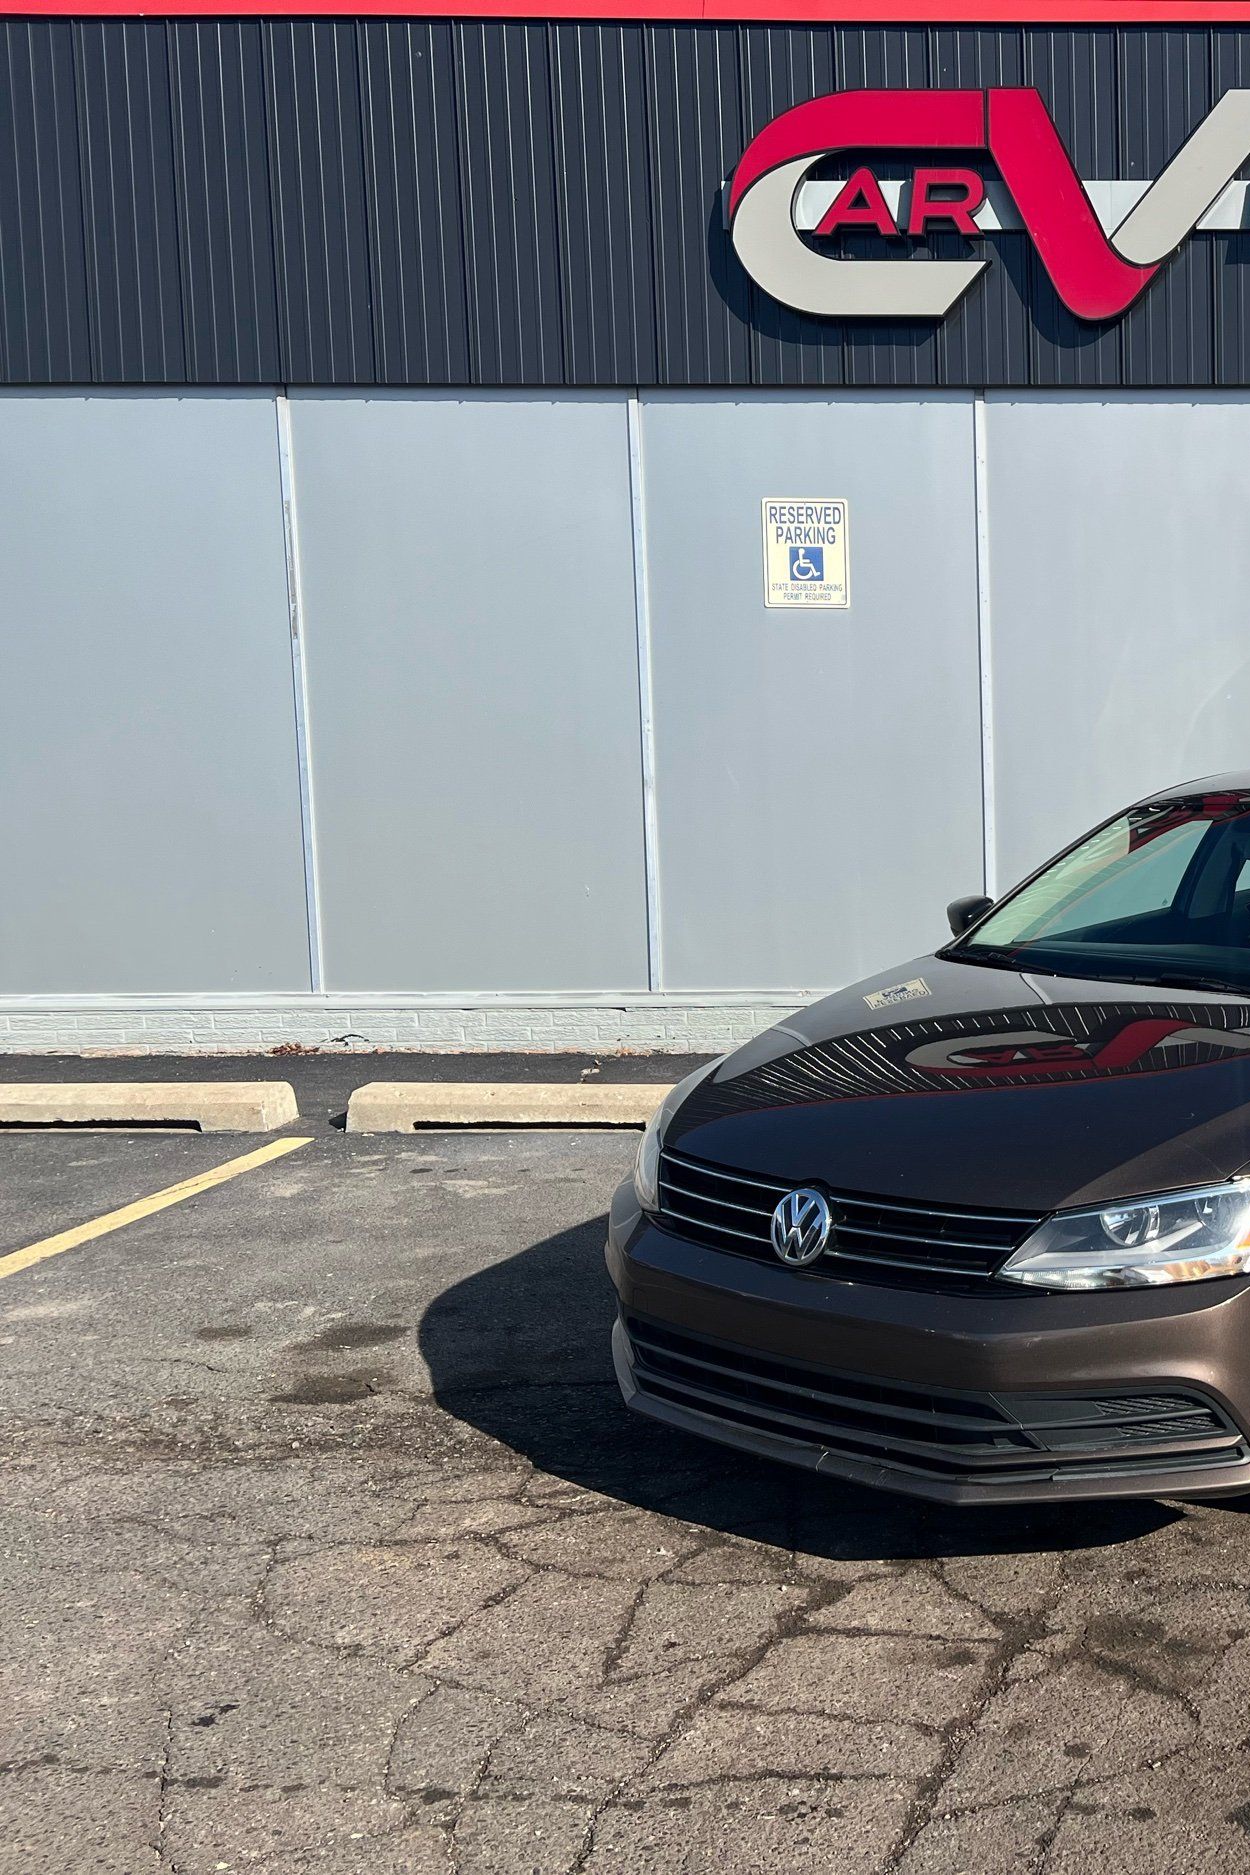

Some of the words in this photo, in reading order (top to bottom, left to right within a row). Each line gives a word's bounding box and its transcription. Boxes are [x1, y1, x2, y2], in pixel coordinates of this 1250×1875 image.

[769, 506, 842, 525] RESERVED
[776, 526, 836, 545] PARKING
[771, 583, 788, 591] STATE
[791, 583, 817, 591] DISABLED
[819, 584, 843, 592] PARKING
[783, 592, 802, 600] PERMIT
[804, 593, 832, 601] REQUIRED
